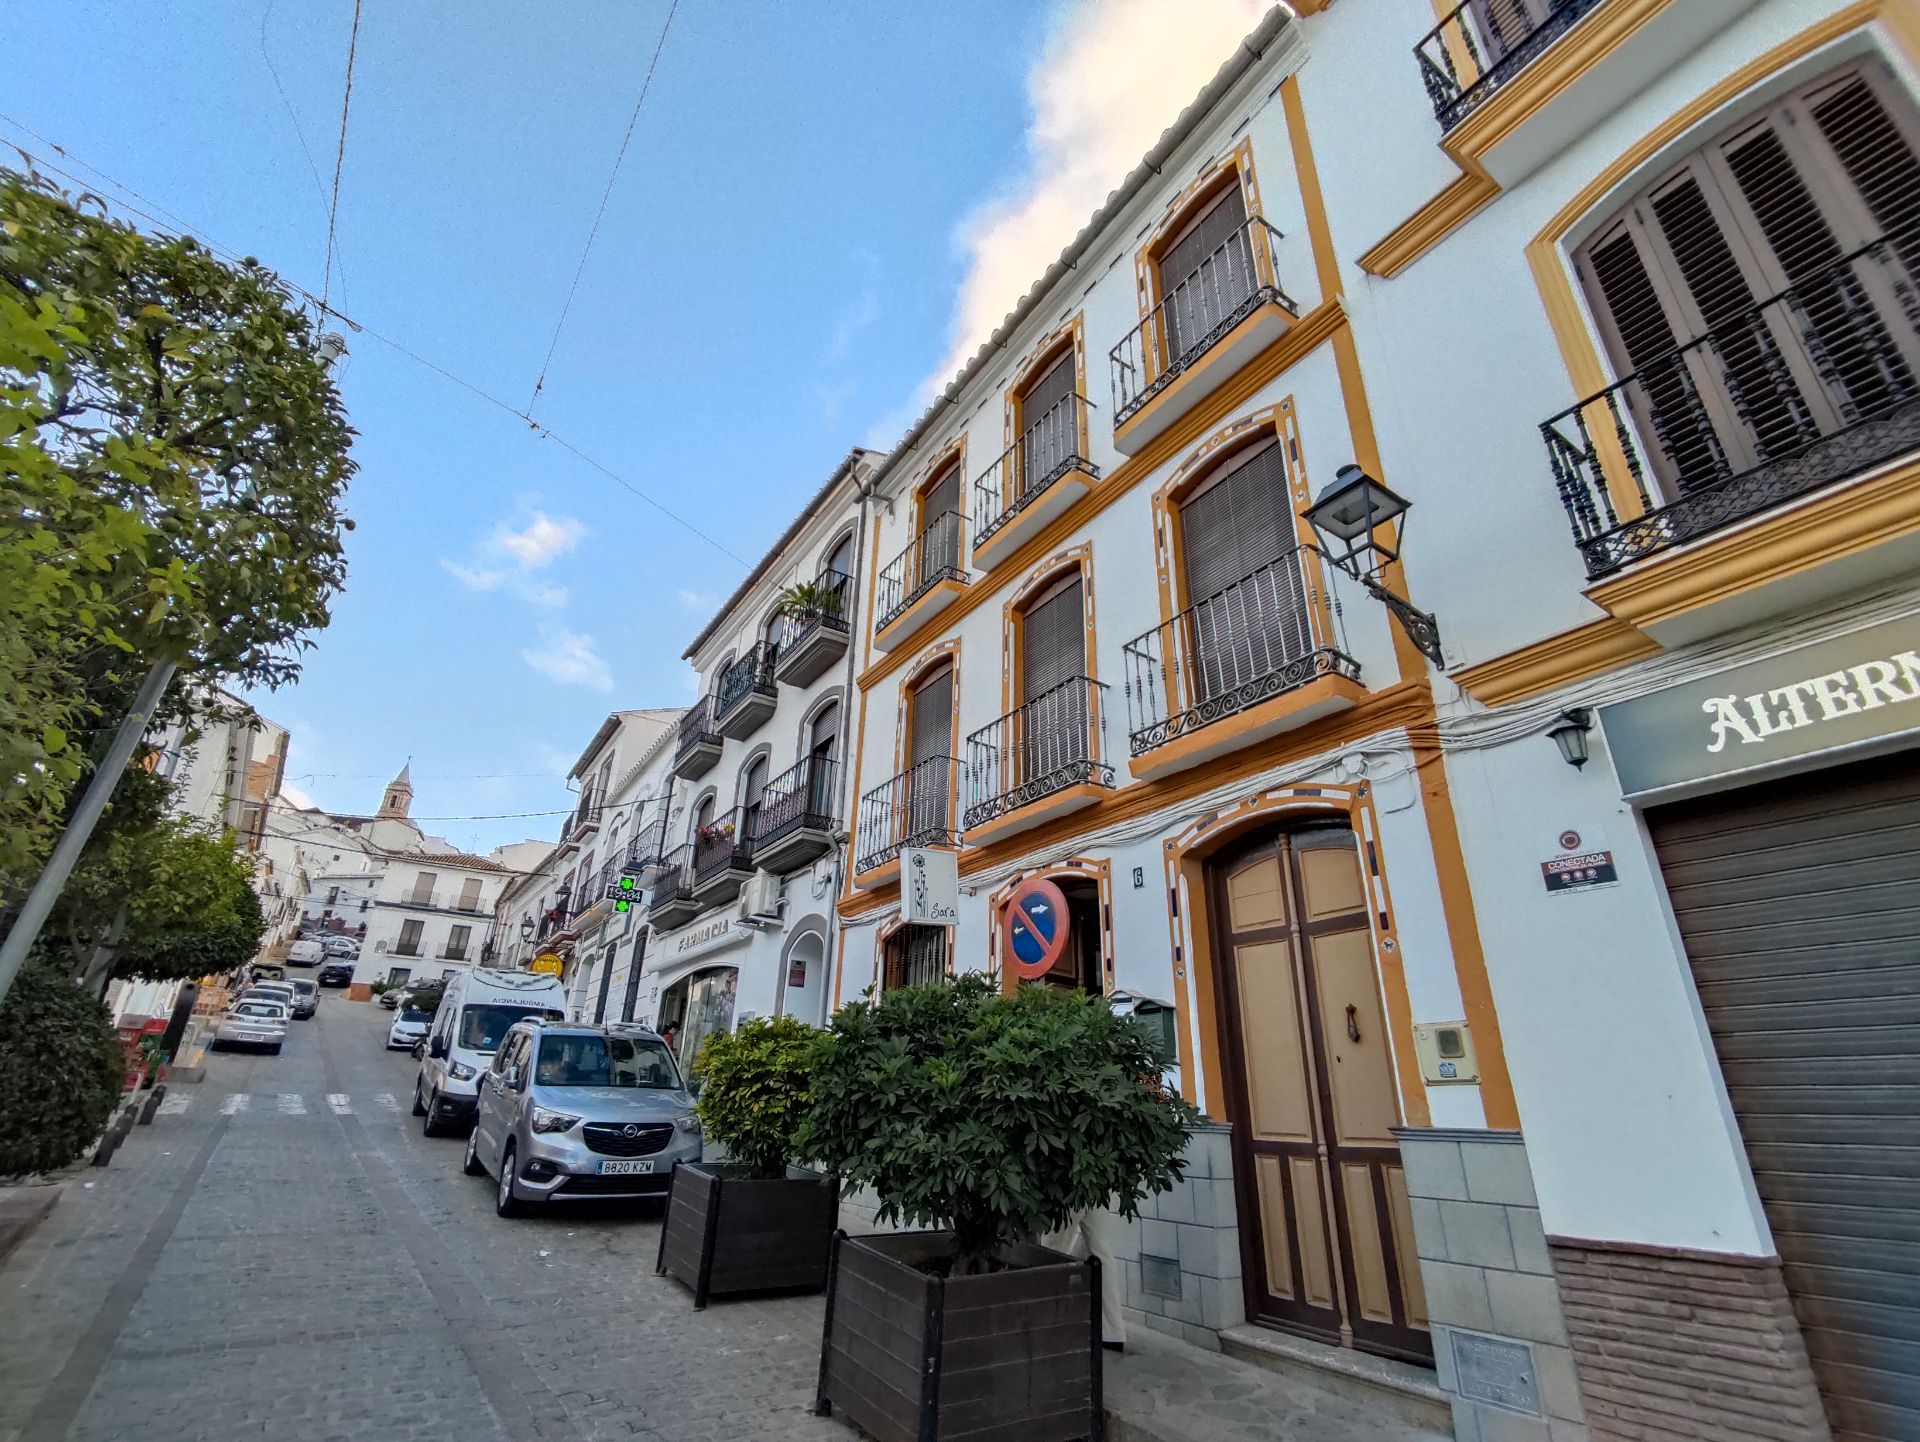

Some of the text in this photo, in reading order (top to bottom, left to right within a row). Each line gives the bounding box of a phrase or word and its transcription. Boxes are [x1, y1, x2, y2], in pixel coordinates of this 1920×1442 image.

[1548, 854, 1606, 869] CONECTADA
[930, 902, 956, 919] Sara
[678, 919, 729, 952] FARMACIA
[604, 1162, 652, 1173] 8820 KZM
